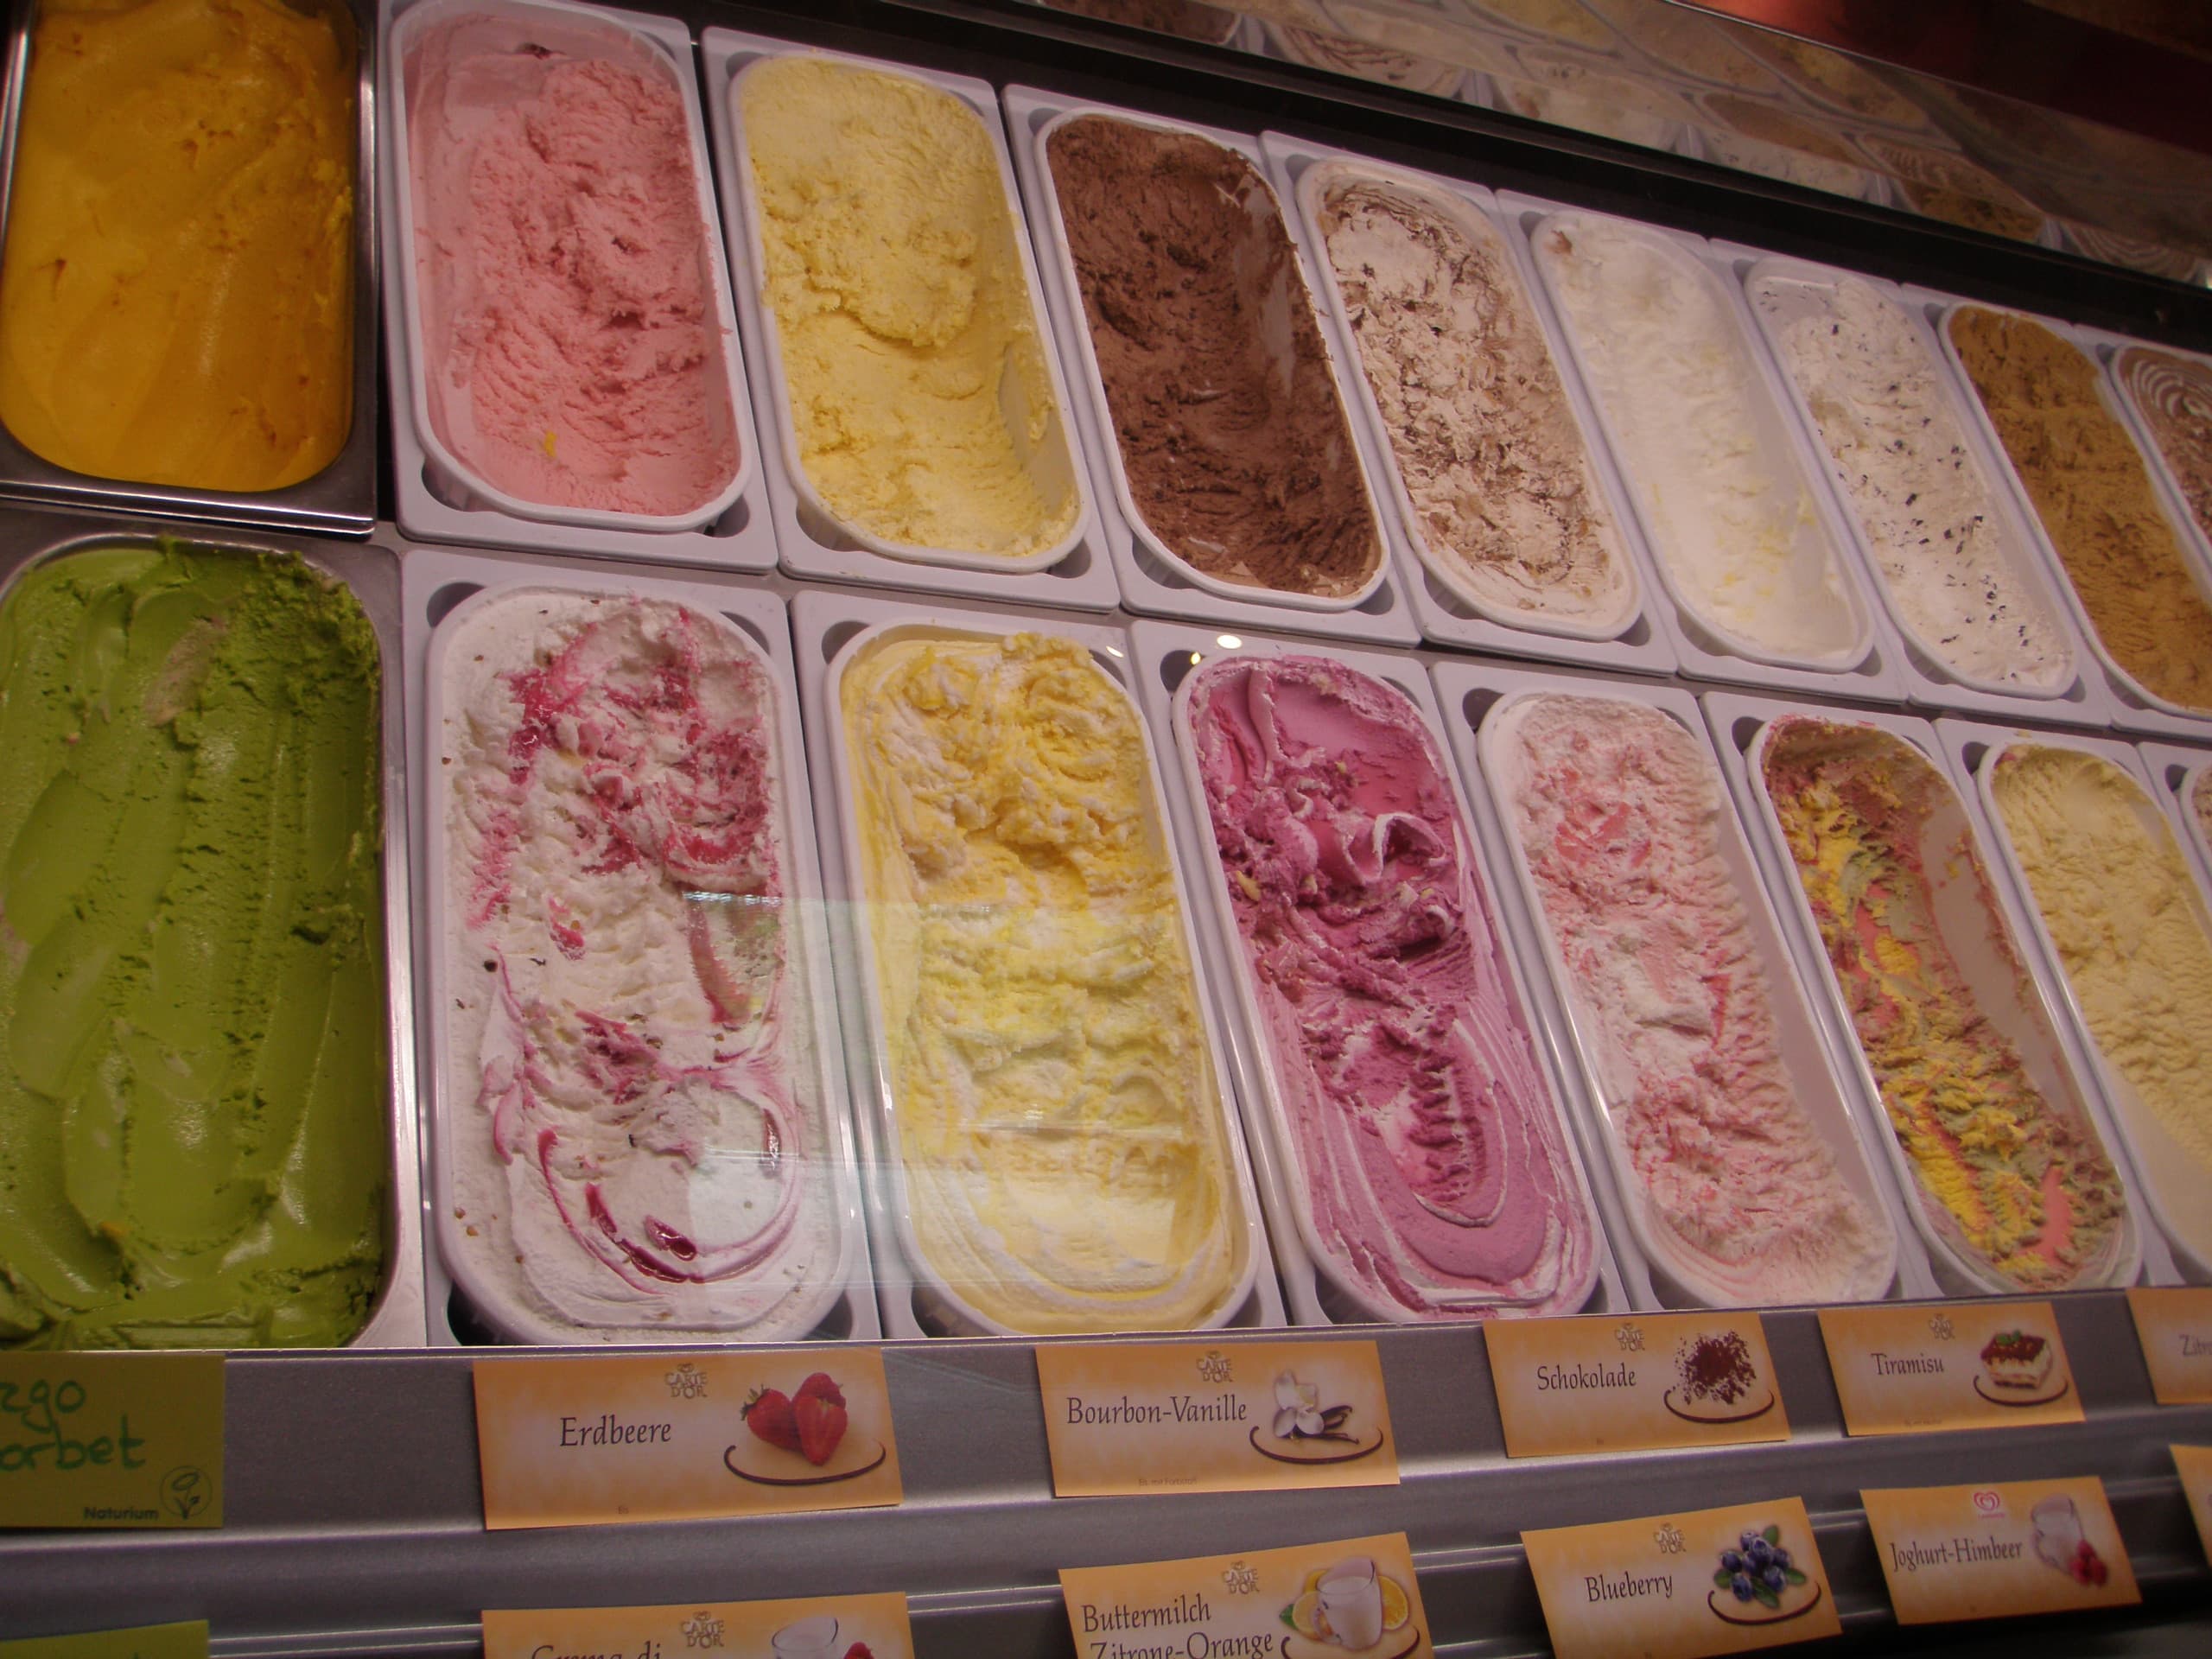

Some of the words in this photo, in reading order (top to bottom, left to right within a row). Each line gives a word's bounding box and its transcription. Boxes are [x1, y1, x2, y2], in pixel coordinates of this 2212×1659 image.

[1537, 1362, 1637, 1390] Schokolade
[1871, 1352, 1944, 1375] Tiramisu
[664, 1371, 709, 1388] CARTE
[671, 1384, 709, 1399] D'OR
[1066, 1394, 1247, 1424] Bourbon-Vanille
[560, 1414, 671, 1446] Erdbeere
[84, 1507, 160, 1521] Naturium
[1890, 1535, 2023, 1572] Joghurt-Himbeer
[1584, 1570, 1673, 1602] Blueberry
[1081, 1593, 1211, 1632] Buttermilch
[680, 1620, 725, 1636] CARTE
